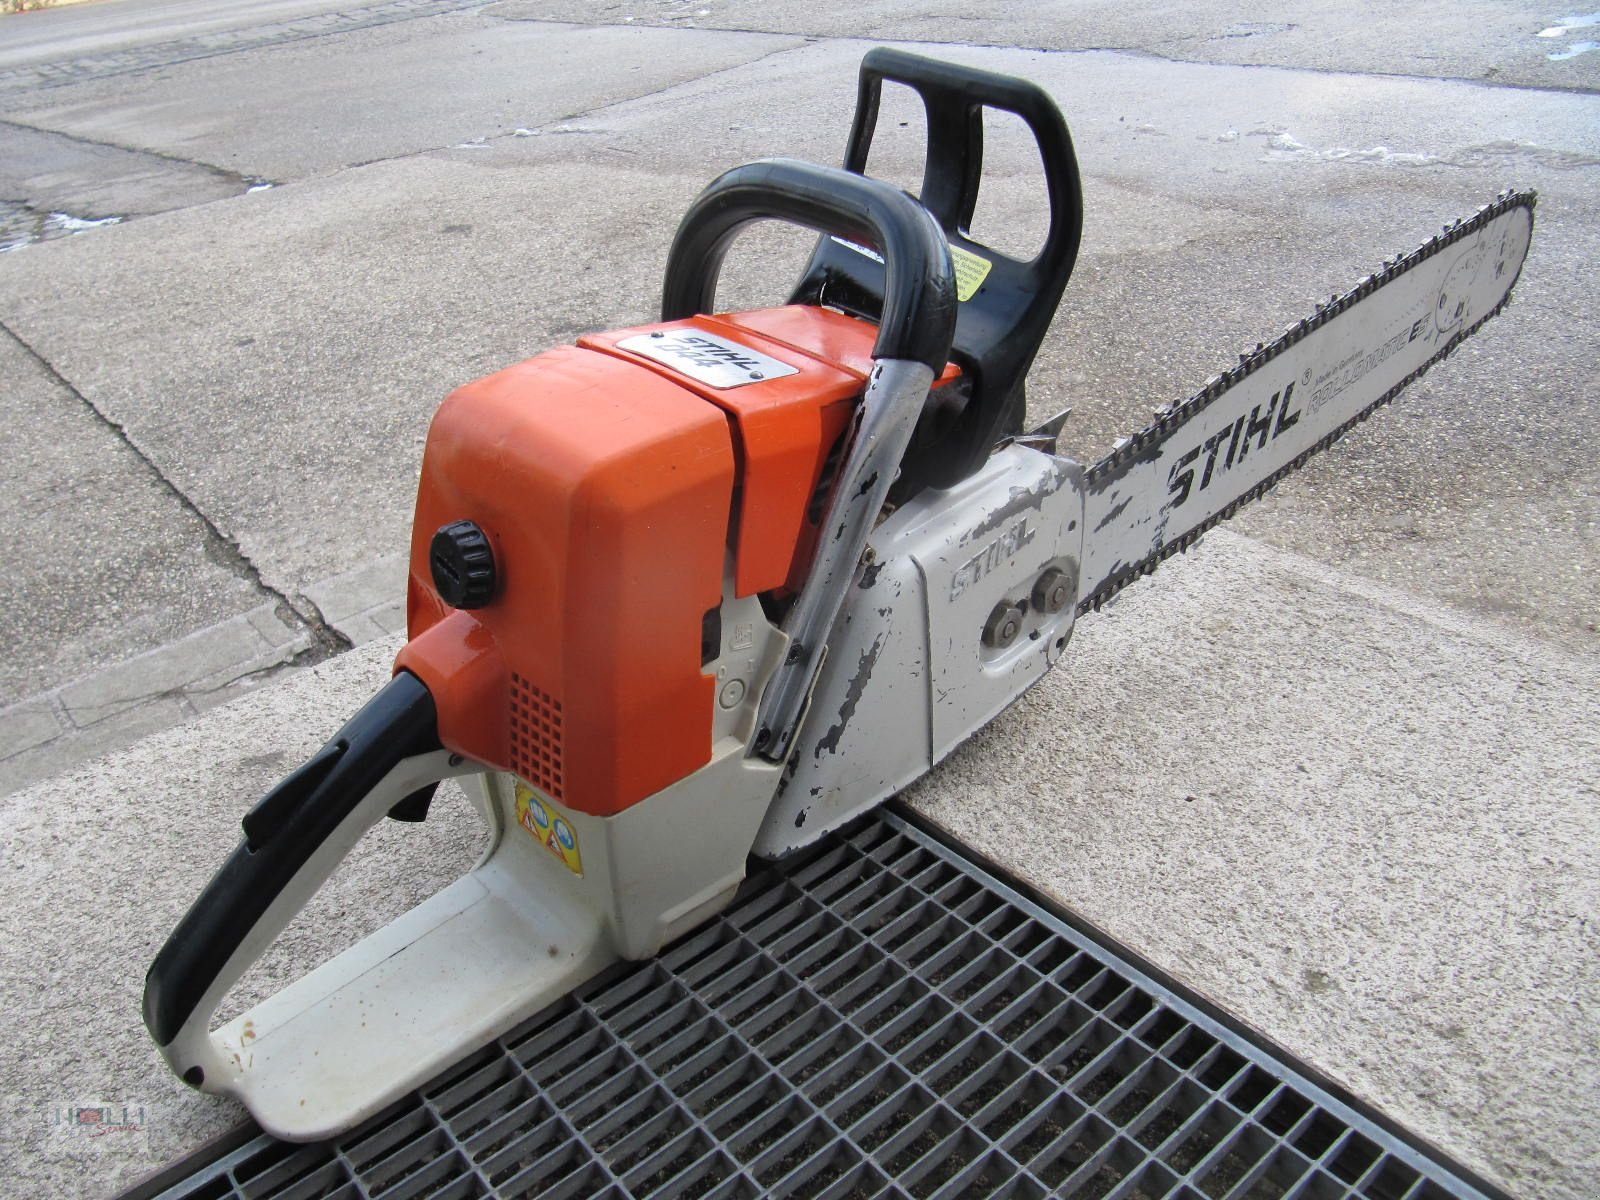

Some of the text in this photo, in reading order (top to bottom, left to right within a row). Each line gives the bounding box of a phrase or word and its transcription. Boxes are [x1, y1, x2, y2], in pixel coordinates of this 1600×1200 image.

[673, 337, 761, 371] STIHL
[1162, 380, 1302, 512] STIHL
[950, 517, 1036, 602] STIHL
